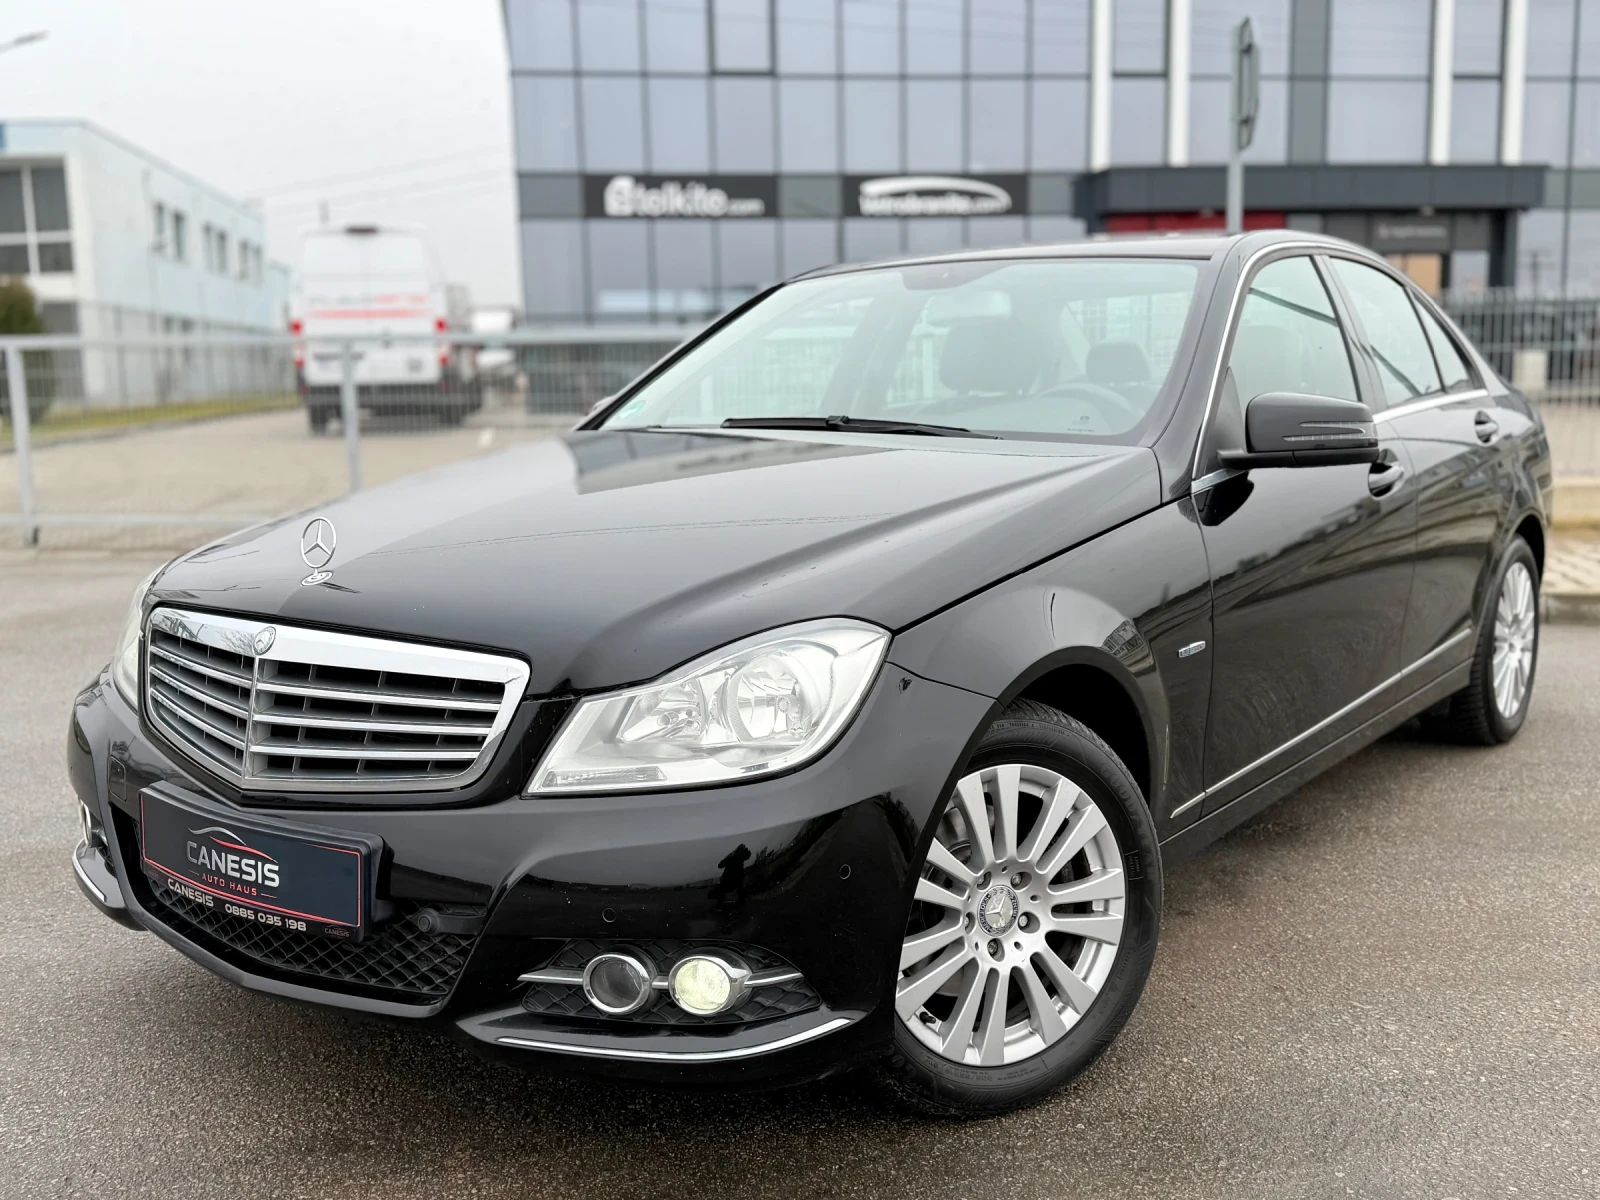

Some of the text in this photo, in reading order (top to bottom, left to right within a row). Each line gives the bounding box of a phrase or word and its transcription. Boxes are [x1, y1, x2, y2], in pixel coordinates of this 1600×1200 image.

[187, 841, 280, 887] CANESIS
[202, 872, 257, 896] AUTO HAUS
[168, 878, 307, 932] CANESIS 0885 035 198
[324, 927, 350, 938] CANESIS
